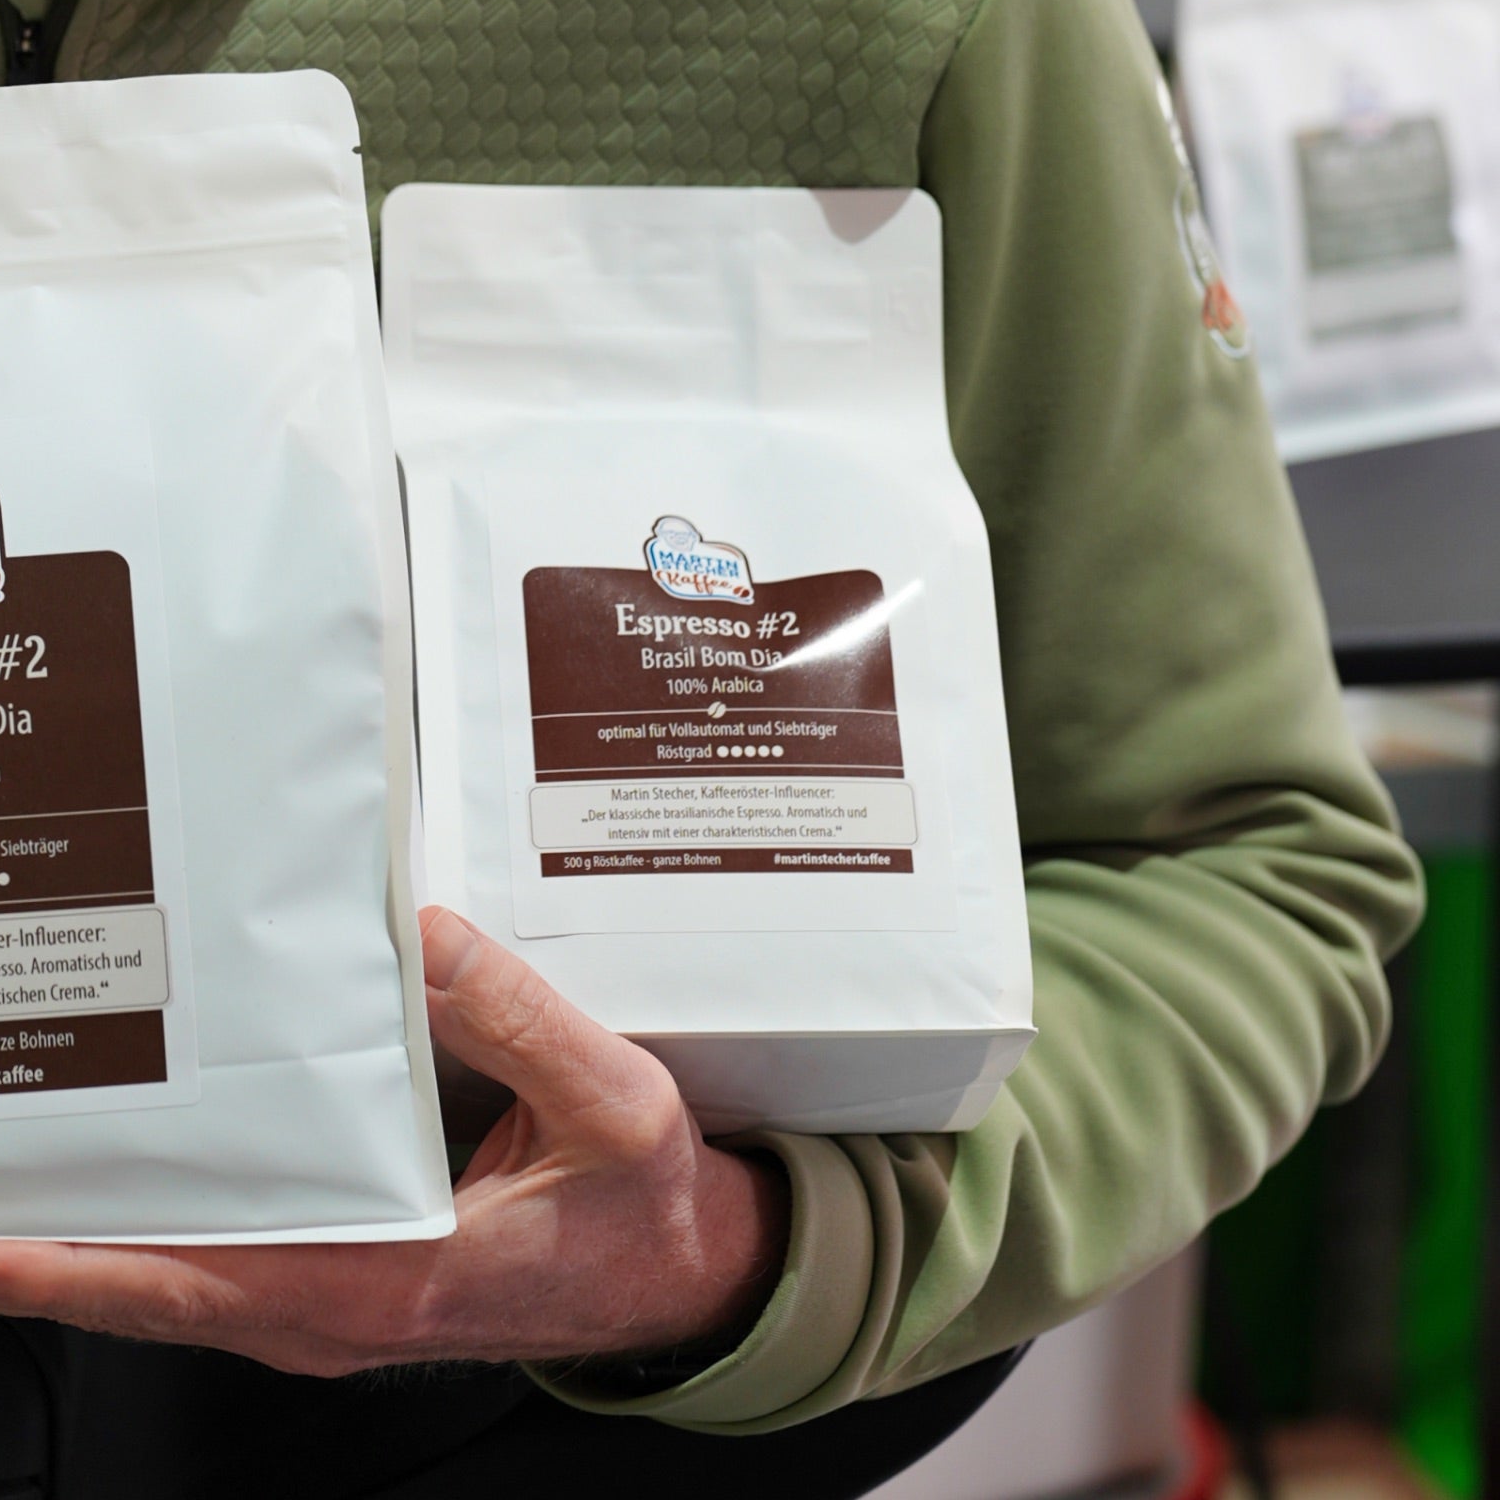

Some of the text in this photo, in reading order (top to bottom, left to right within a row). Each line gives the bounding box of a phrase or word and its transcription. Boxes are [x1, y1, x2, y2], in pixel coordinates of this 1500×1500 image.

[659, 550, 738, 570] MARTIN
[656, 570, 732, 595] Kaffee
[615, 603, 799, 641] Espresso #2
[641, 648, 782, 669] Brasil Bom Dia
[666, 677, 764, 695] 100% Arabica
[598, 722, 837, 741] optimal für Vollautomat und Siebträger
[657, 744, 712, 760] Röstgrad
[611, 785, 835, 800] Martin Stecher, Kaffeeröster-Influencer:
[609, 807, 661, 820] klassische
[663, 806, 735, 819] brasilianische
[737, 806, 783, 820] Espresso.
[787, 806, 845, 819] Aromatisch
[847, 807, 867, 819] und
[608, 828, 649, 839] intensiv
[652, 827, 670, 839] mit
[673, 826, 700, 838] einer
[702, 825, 797, 838] charakteristischen
[0, 837, 69, 860] Siebträger
[564, 856, 583, 869] 500
[584, 859, 591, 871] g
[593, 855, 644, 867] Röstkaffee
[652, 857, 681, 869] ganze
[684, 854, 721, 866] Bohnen
[774, 853, 891, 867] #martinstecherkaffee
[31, 951, 111, 975] Aromatisch
[114, 950, 142, 968] und
[50, 980, 109, 1001] Crema.“
[19, 1030, 75, 1050] Bohnen
